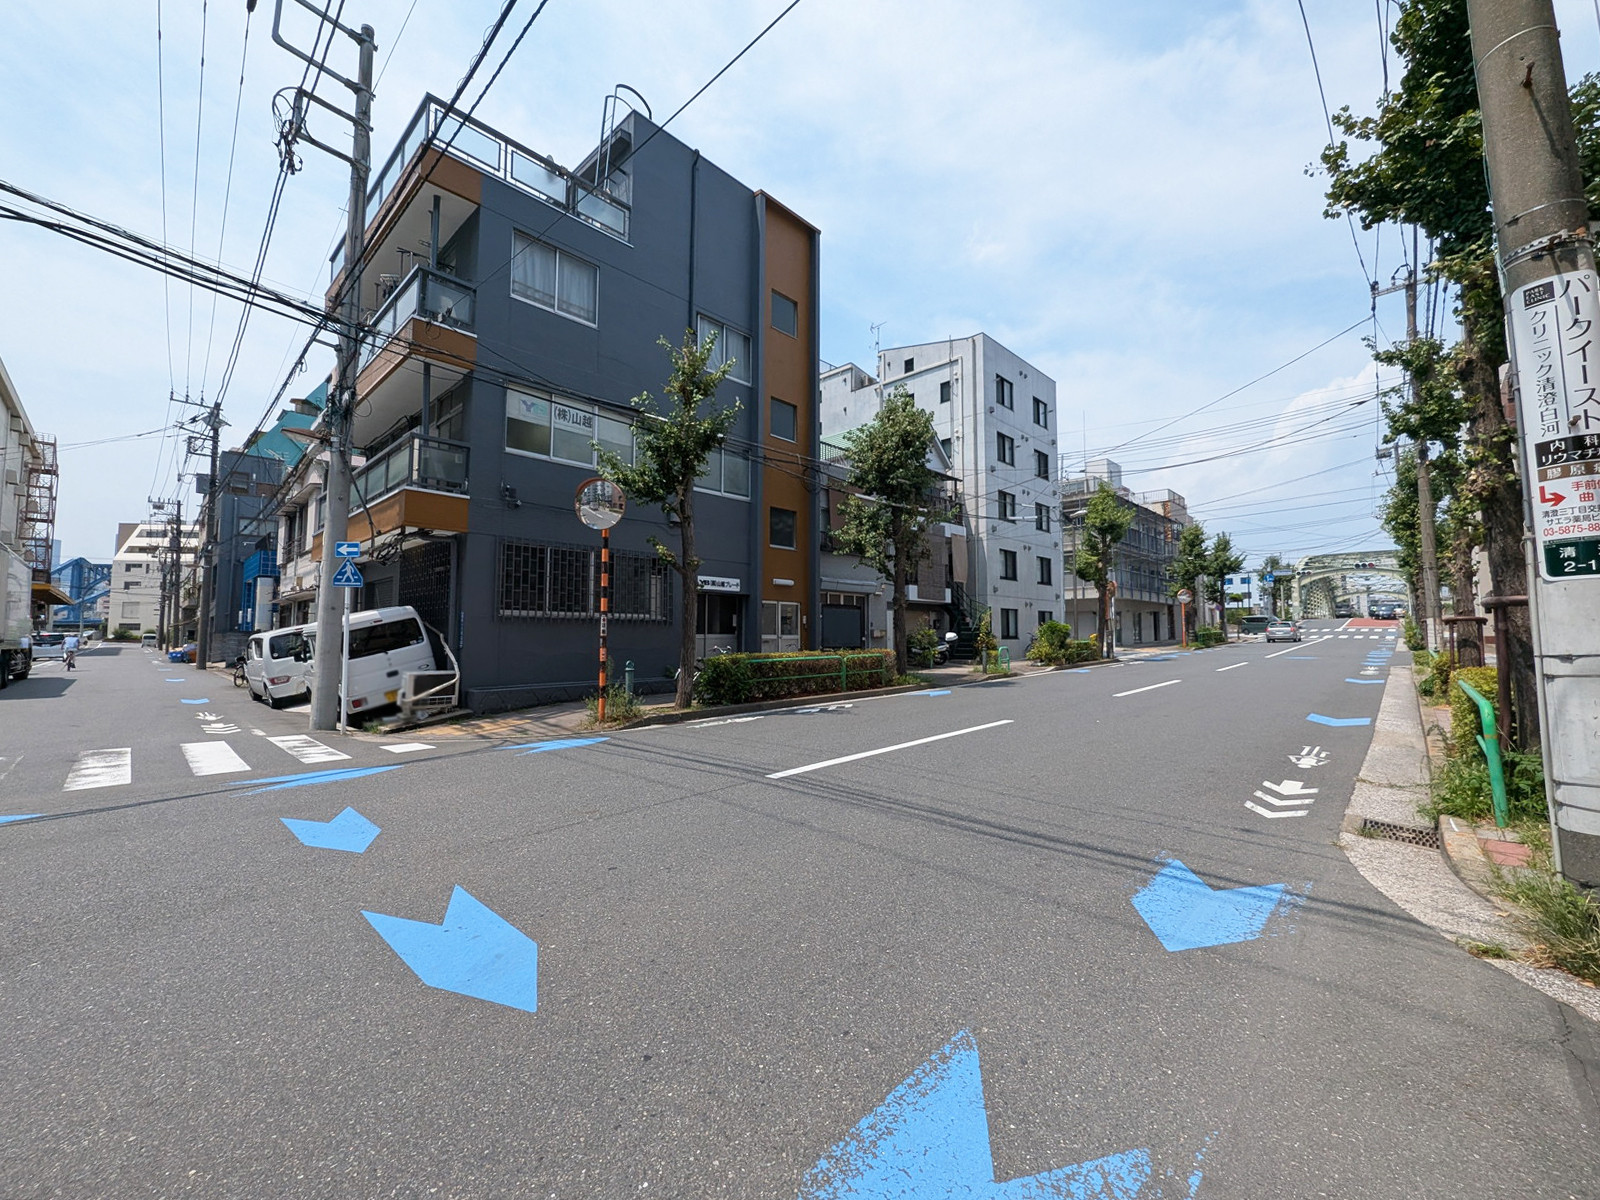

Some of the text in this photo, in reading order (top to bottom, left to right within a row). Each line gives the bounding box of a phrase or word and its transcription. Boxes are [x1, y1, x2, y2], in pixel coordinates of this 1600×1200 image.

[1525, 287, 1544, 296] PARK
[1525, 291, 1544, 300] EAST
[1526, 293, 1551, 305] CLINIC
[1559, 274, 1600, 430] パークイースト
[1530, 310, 1560, 438] クリニック清澄白河
[554, 405, 593, 429] (株)山越
[1541, 447, 1600, 466] リウマチ
[1571, 479, 1600, 492] 手前
[1542, 504, 1600, 518] 清澄三丁目交
[1543, 522, 1600, 537] 03-5875-88
[1559, 543, 1600, 559] 清
[1563, 559, 1597, 572] 2-1
